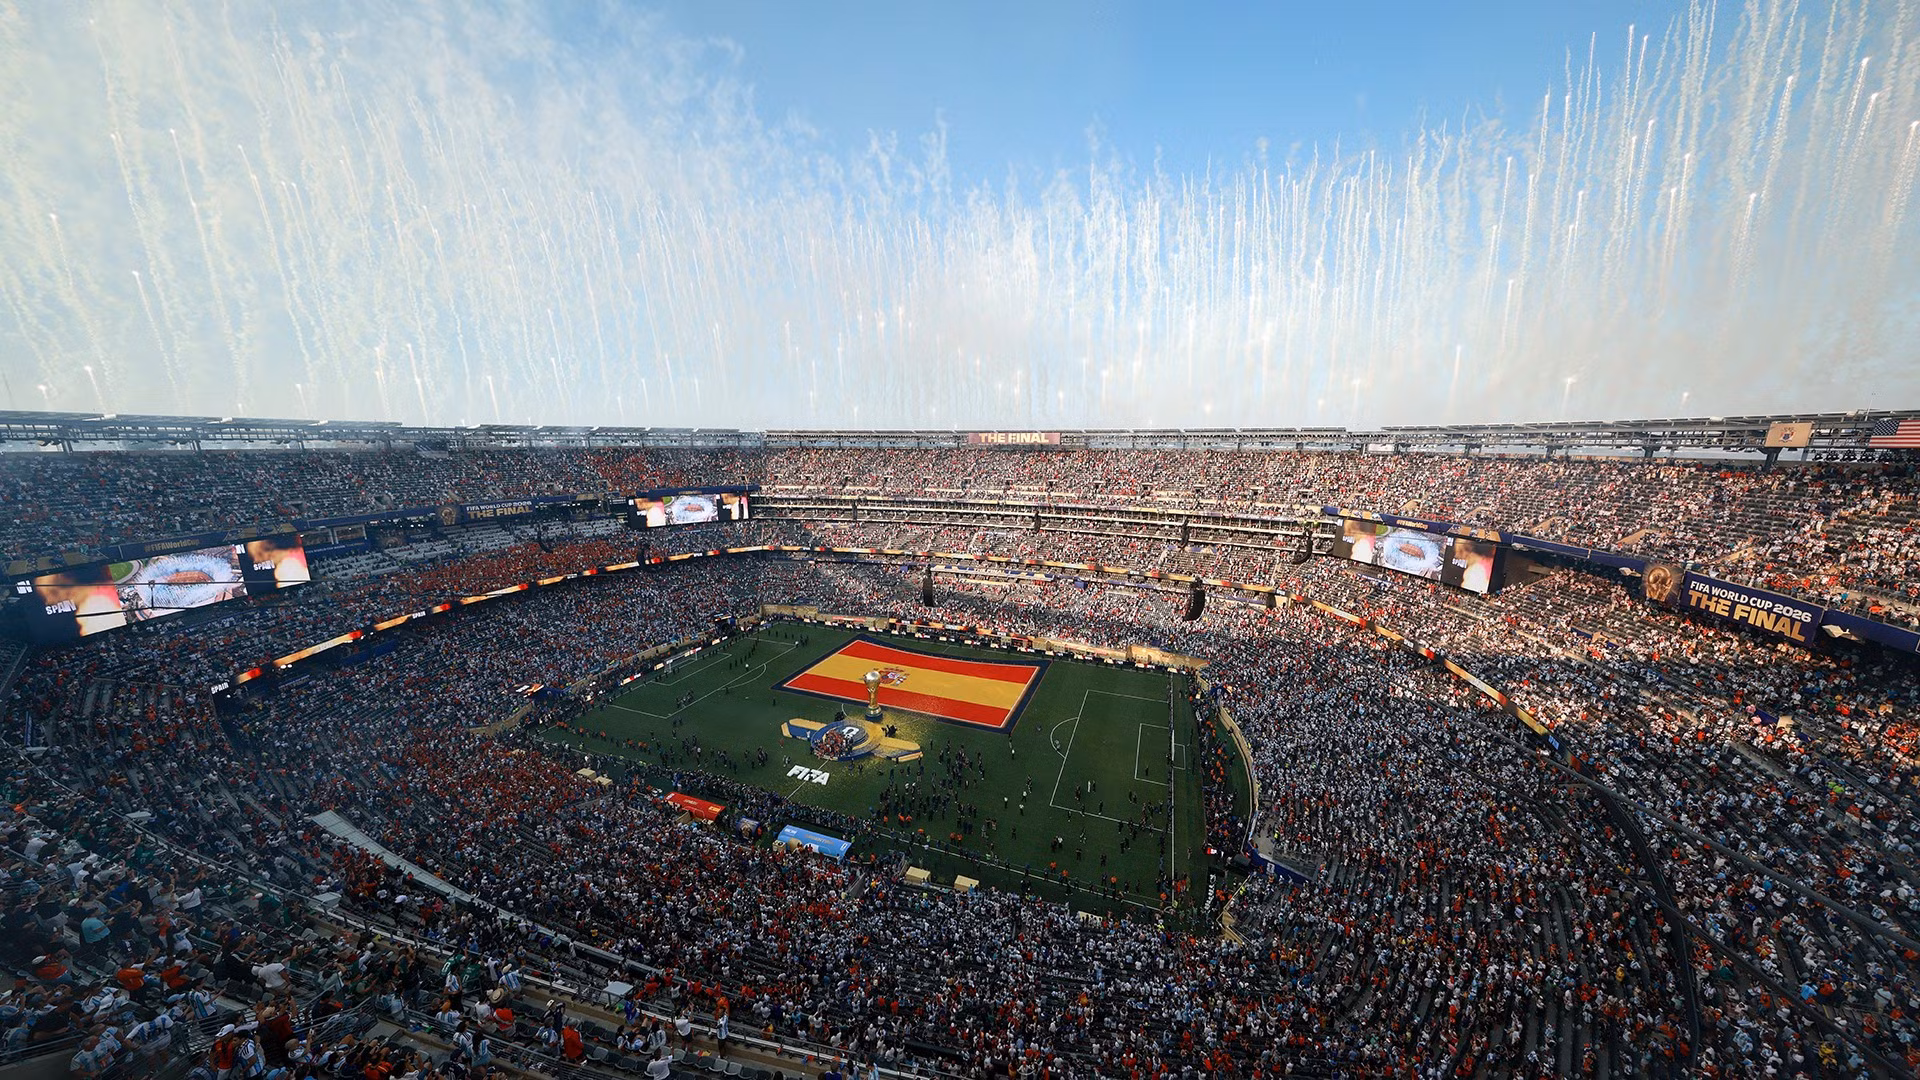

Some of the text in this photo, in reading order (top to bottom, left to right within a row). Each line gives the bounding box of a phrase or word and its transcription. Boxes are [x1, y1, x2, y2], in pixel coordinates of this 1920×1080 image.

[979, 433, 1049, 443] THE FINAL
[468, 506, 532, 519] THE FINAL
[144, 539, 200, 552] #FIFAWorldCup
[253, 560, 275, 571] SPAIN
[45, 600, 76, 615] SPAIN
[1690, 581, 1812, 623] FIFA WORLD CUP 2026
[1688, 590, 1806, 642] THE FINAL
[211, 682, 229, 694] SPAIN
[787, 765, 830, 786] FIFA
